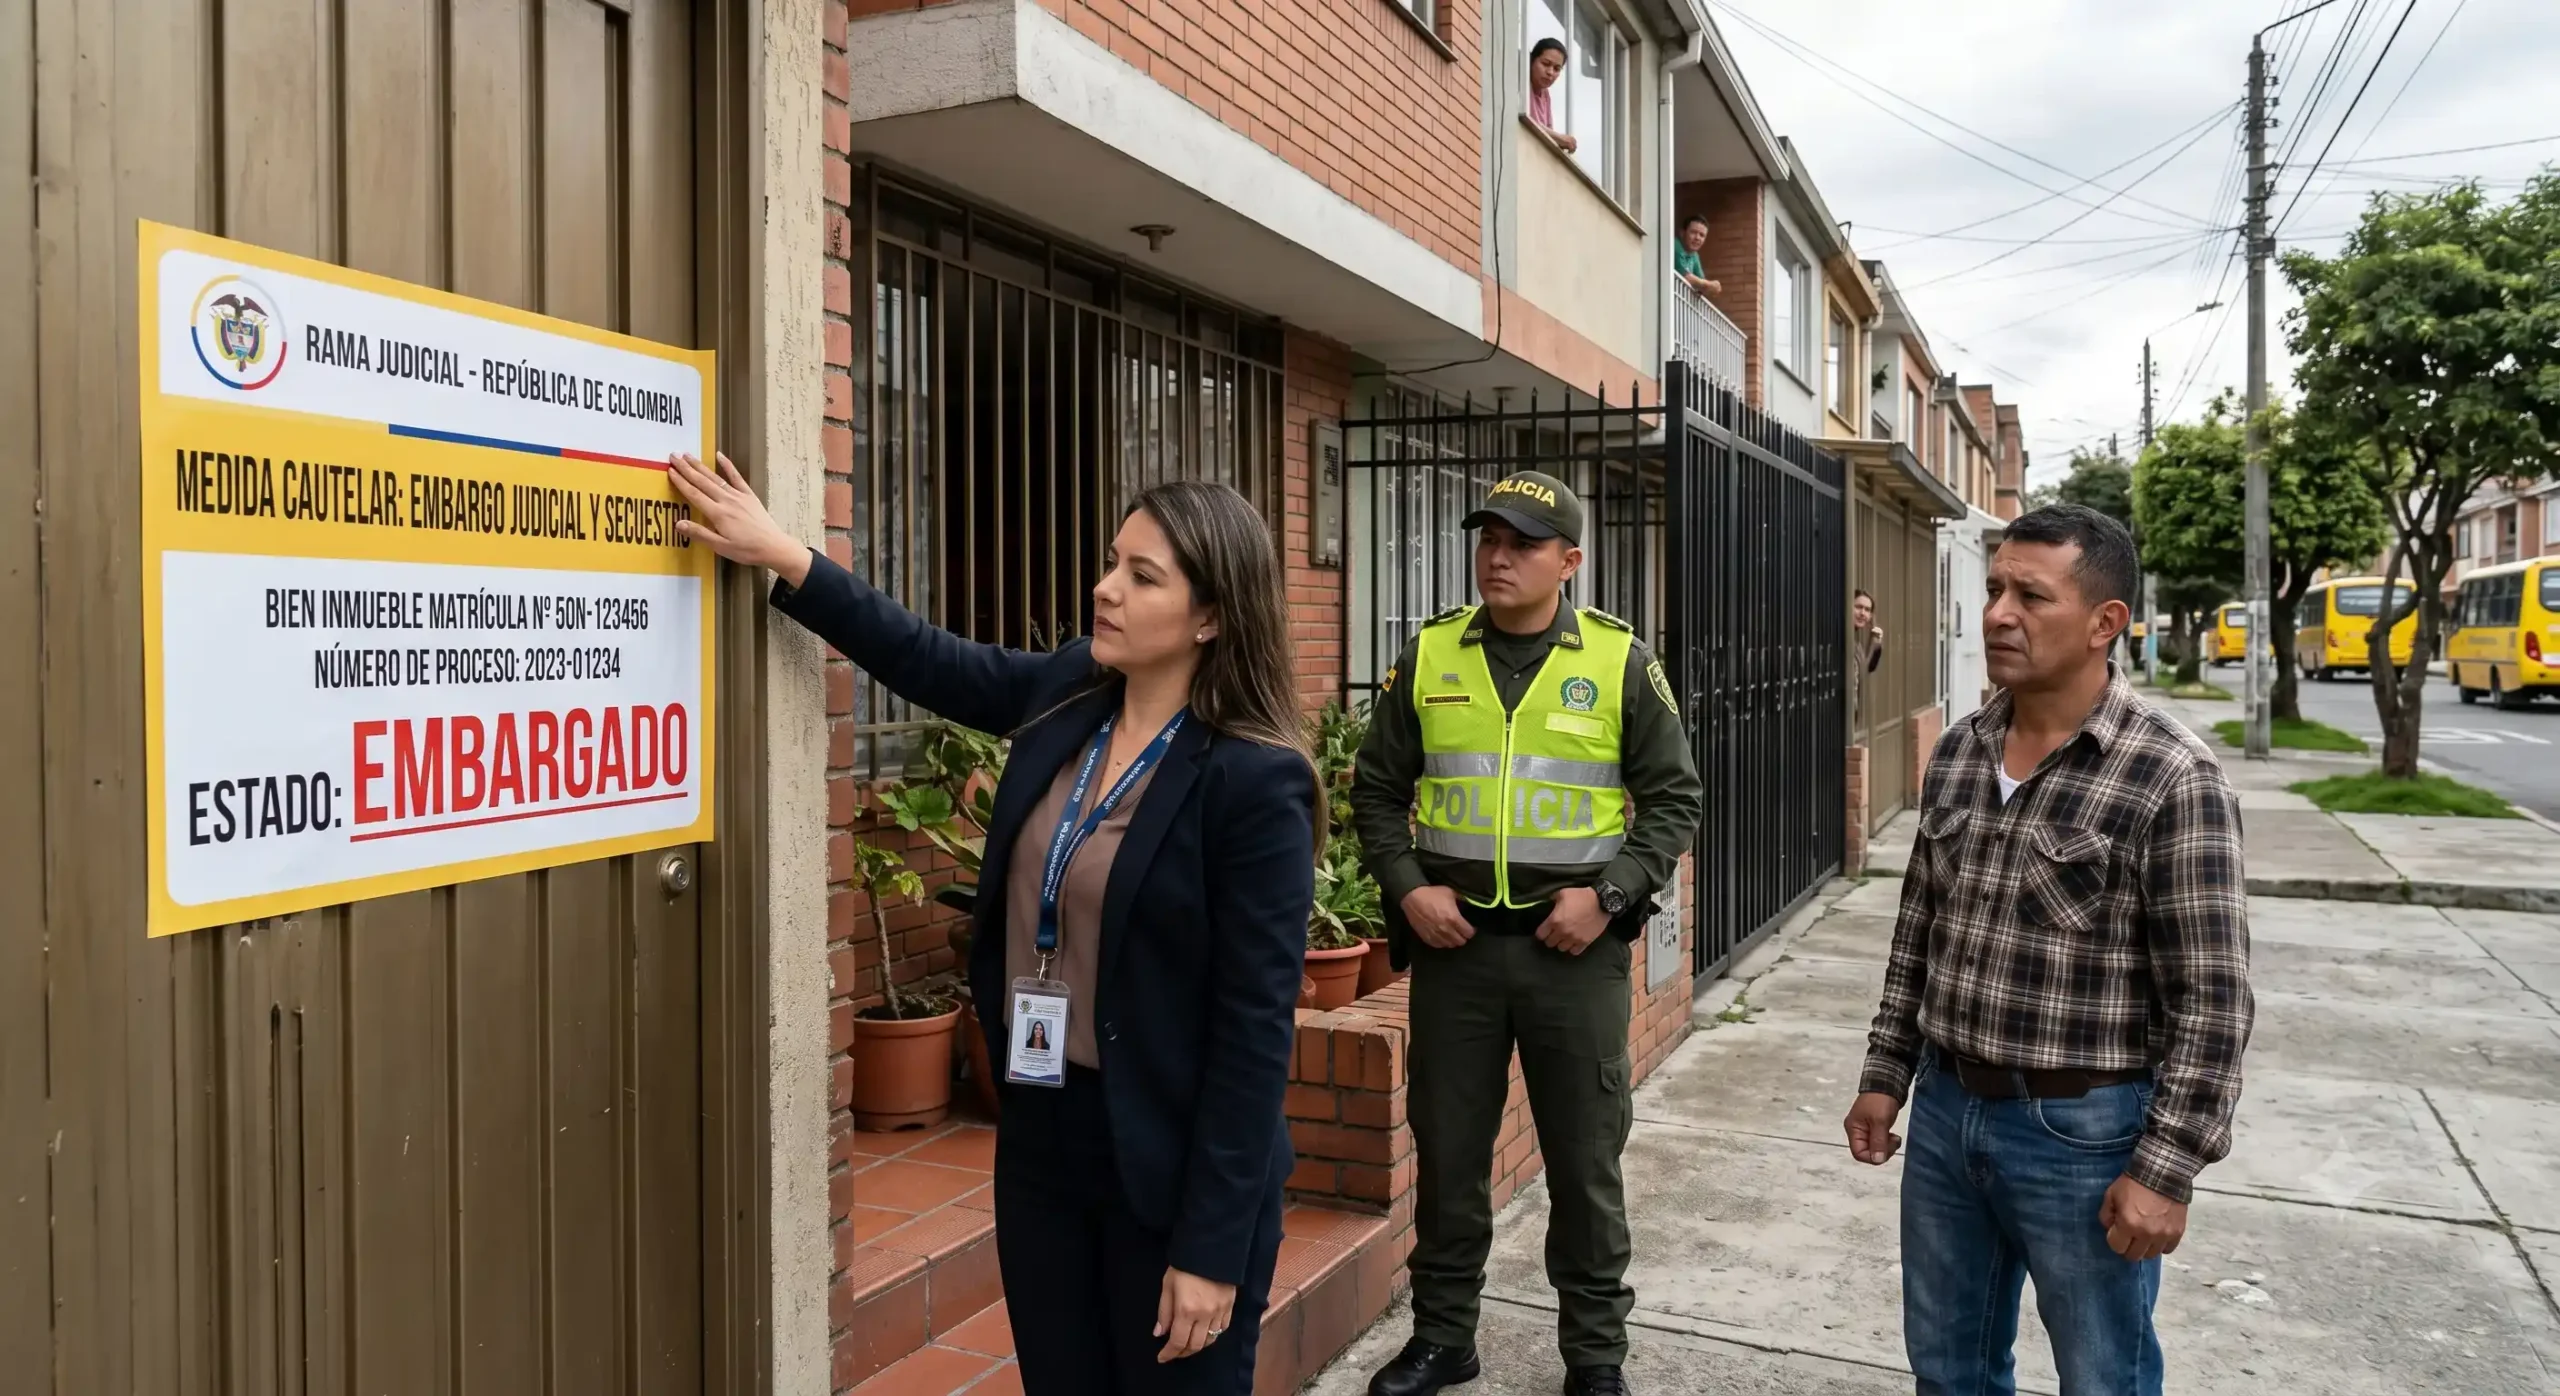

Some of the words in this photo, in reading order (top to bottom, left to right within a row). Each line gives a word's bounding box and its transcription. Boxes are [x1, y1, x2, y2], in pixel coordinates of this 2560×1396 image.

[306, 324, 371, 372] RAMA
[376, 338, 464, 388] JUDICIAL
[482, 358, 579, 408] REPÚBLICA
[583, 378, 604, 412] DE
[608, 383, 683, 427] COLOMBIA
[176, 448, 276, 518] MEDIDA
[283, 459, 404, 527] CAUTELAR:
[410, 473, 505, 535] EMBARGO
[510, 484, 586, 541] JUDICIAL
[589, 493, 600, 541] Y
[605, 494, 691, 549] SECUESTRO
[266, 588, 315, 629] BIEN
[322, 589, 424, 629] INMUEBLE
[429, 586, 528, 630] MATRÍCULA
[555, 596, 649, 631] 50N-123456
[315, 641, 400, 689] NÚMERO
[406, 648, 430, 686] DE
[436, 647, 520, 685] PROCESO:
[525, 647, 621, 682] 2023-01234
[189, 771, 342, 847] ESTADO:
[353, 702, 687, 825] EMBARGADO
[1430, 782, 1596, 832] POLICIA
